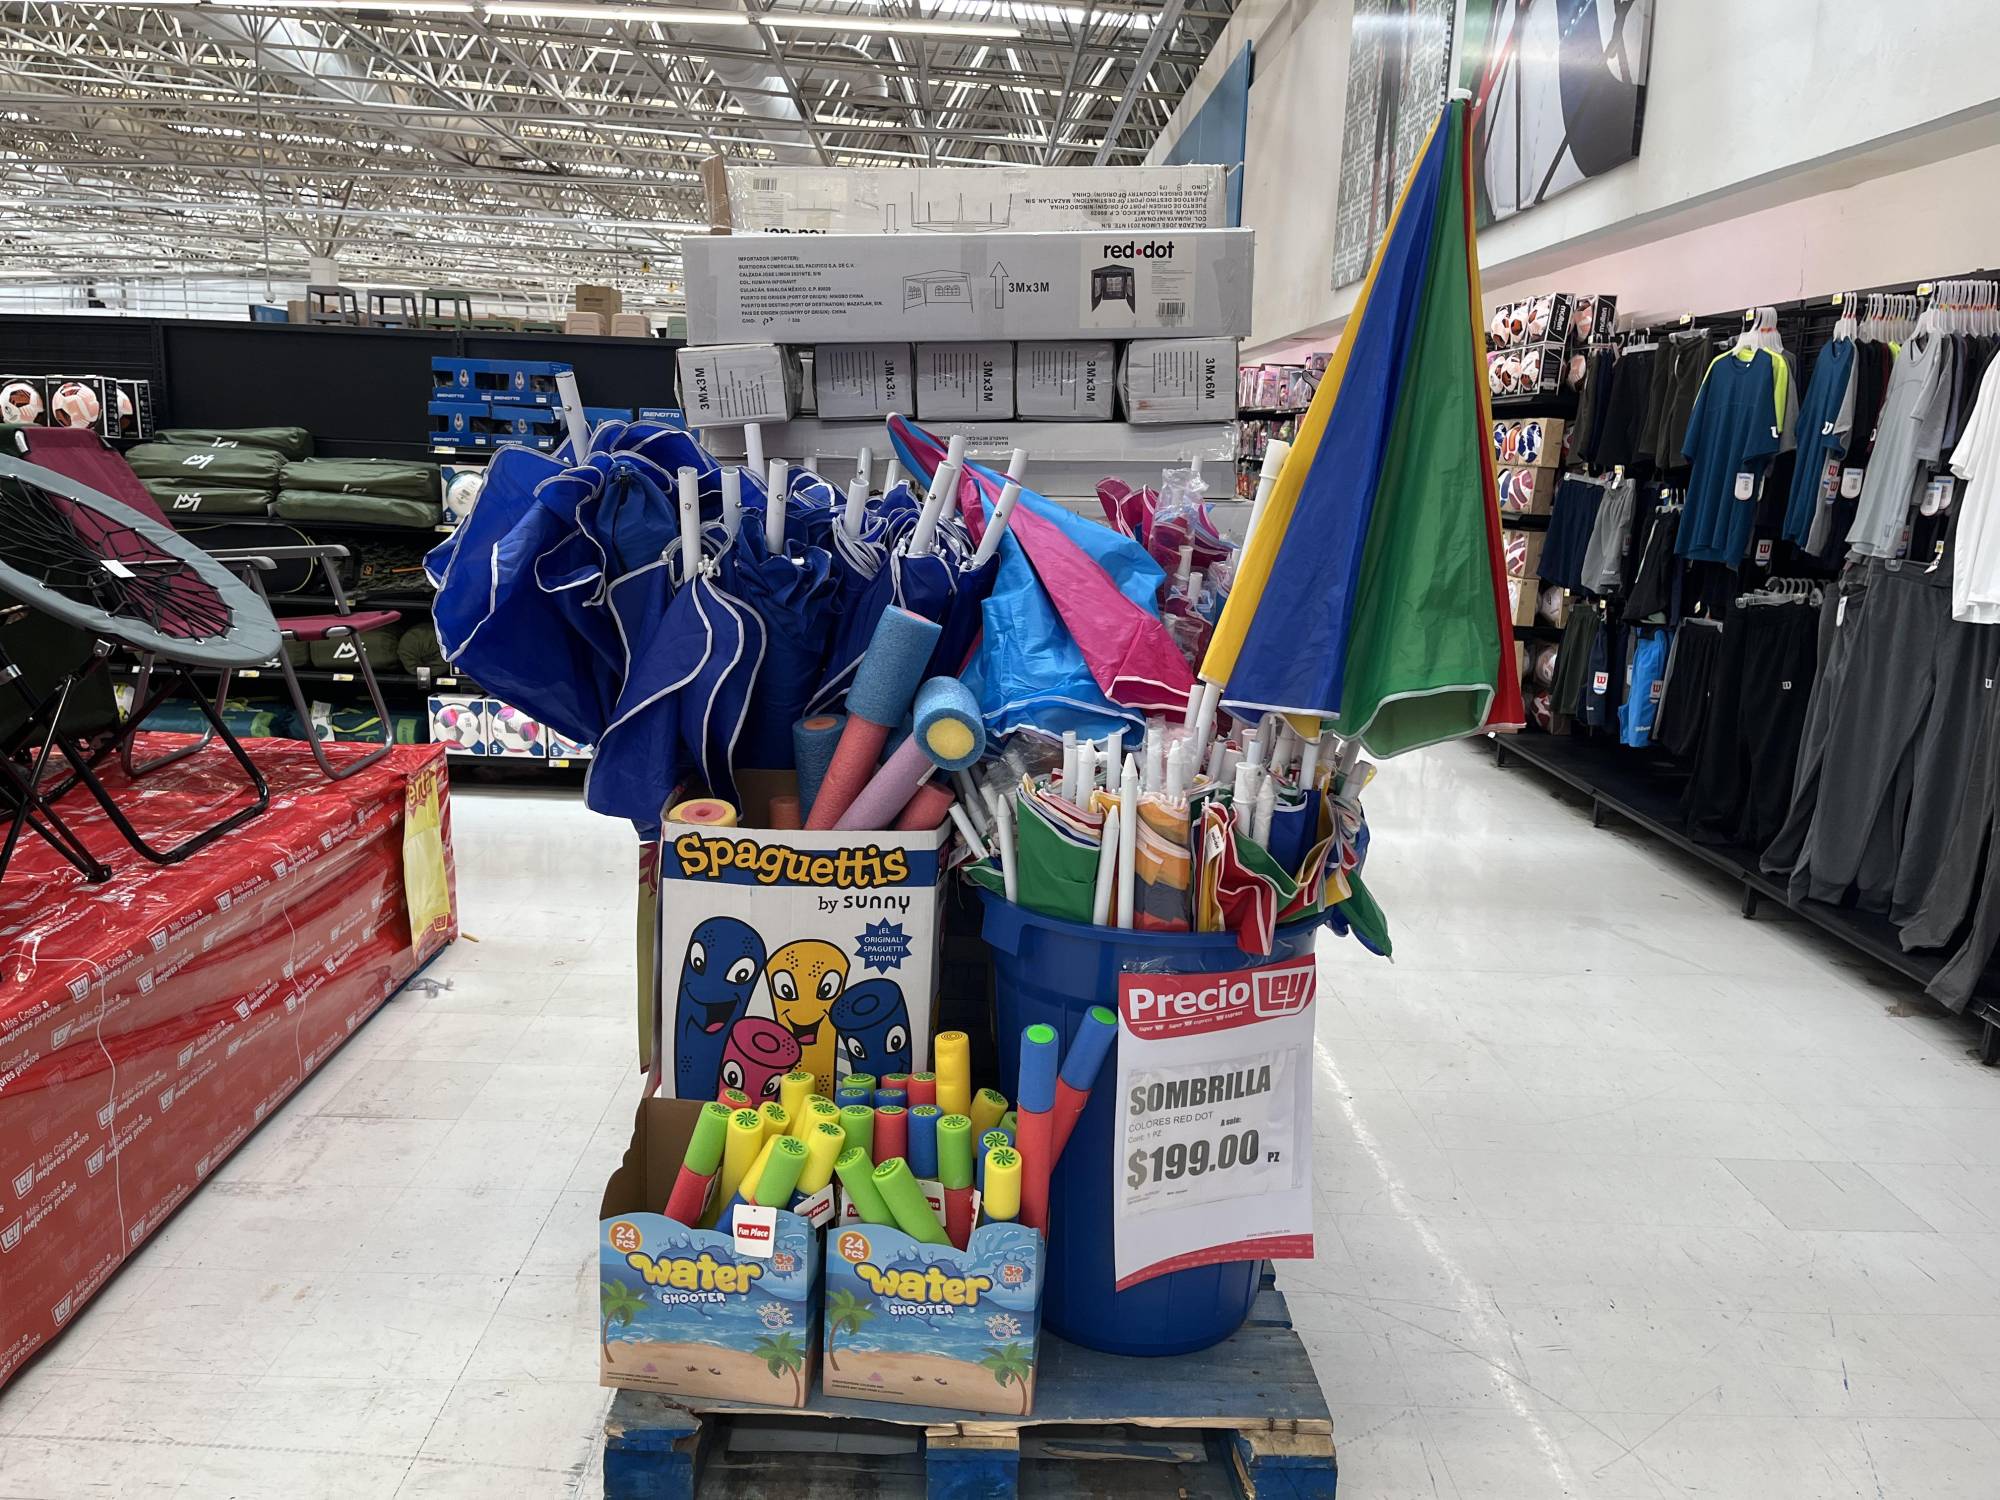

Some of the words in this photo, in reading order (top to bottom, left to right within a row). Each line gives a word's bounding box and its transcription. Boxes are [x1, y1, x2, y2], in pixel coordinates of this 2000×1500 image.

[1009, 282, 1049, 292] 3Mx3M
[695, 368, 710, 410] 3Mx3M
[983, 360, 993, 402] 3Mx3M
[1086, 360, 1096, 402] 3Mx3M
[1206, 358, 1215, 399] 3Mx6M
[676, 833, 908, 888] Spaguettis
[818, 896, 838, 913] by
[844, 896, 910, 914] sunny
[107, 954, 126, 968] Cosas
[127, 950, 133, 958] a
[869, 955, 897, 963] sunny
[92, 968, 121, 990] mejores
[122, 953, 145, 973] precios
[1128, 979, 1250, 1020] Precio
[1256, 972, 1311, 1012] Ley
[18, 1004, 41, 1020] Cosas
[42, 1000, 49, 1009] a
[0, 1021, 33, 1046] mejores
[34, 1004, 61, 1027] precios
[1130, 1065, 1271, 1116] SOMBRILLA
[121, 1120, 138, 1135] Cosas
[1128, 1118, 1171, 1133] COLORES
[1173, 1115, 1192, 1124] RED
[1195, 1111, 1214, 1121] DOT
[54, 1138, 73, 1155] Cosas
[73, 1131, 78, 1139] a
[106, 1135, 132, 1162] mejores
[133, 1116, 152, 1139] precios
[36, 1152, 65, 1183] mejores
[67, 1133, 89, 1159] precios
[1127, 1129, 1259, 1190] $199.00
[1267, 1152, 1280, 1163] PZ
[40, 1186, 60, 1206] Cosas
[61, 1180, 66, 1189] a
[24, 1204, 52, 1235] mejores
[54, 1182, 77, 1210] precios
[812, 1202, 830, 1215] Place
[616, 1227, 636, 1240] 24
[616, 1239, 636, 1249] PCS
[738, 1227, 749, 1236] Fun
[750, 1228, 769, 1238] Place
[846, 1236, 864, 1250] 24
[774, 1253, 794, 1265] 3+
[845, 1250, 864, 1259] PCS
[627, 1252, 763, 1293] water
[1003, 1265, 1023, 1276] 3+
[855, 1263, 992, 1306] water
[662, 1292, 726, 1304] SHOOTER
[890, 1304, 954, 1316] SHOOTER
